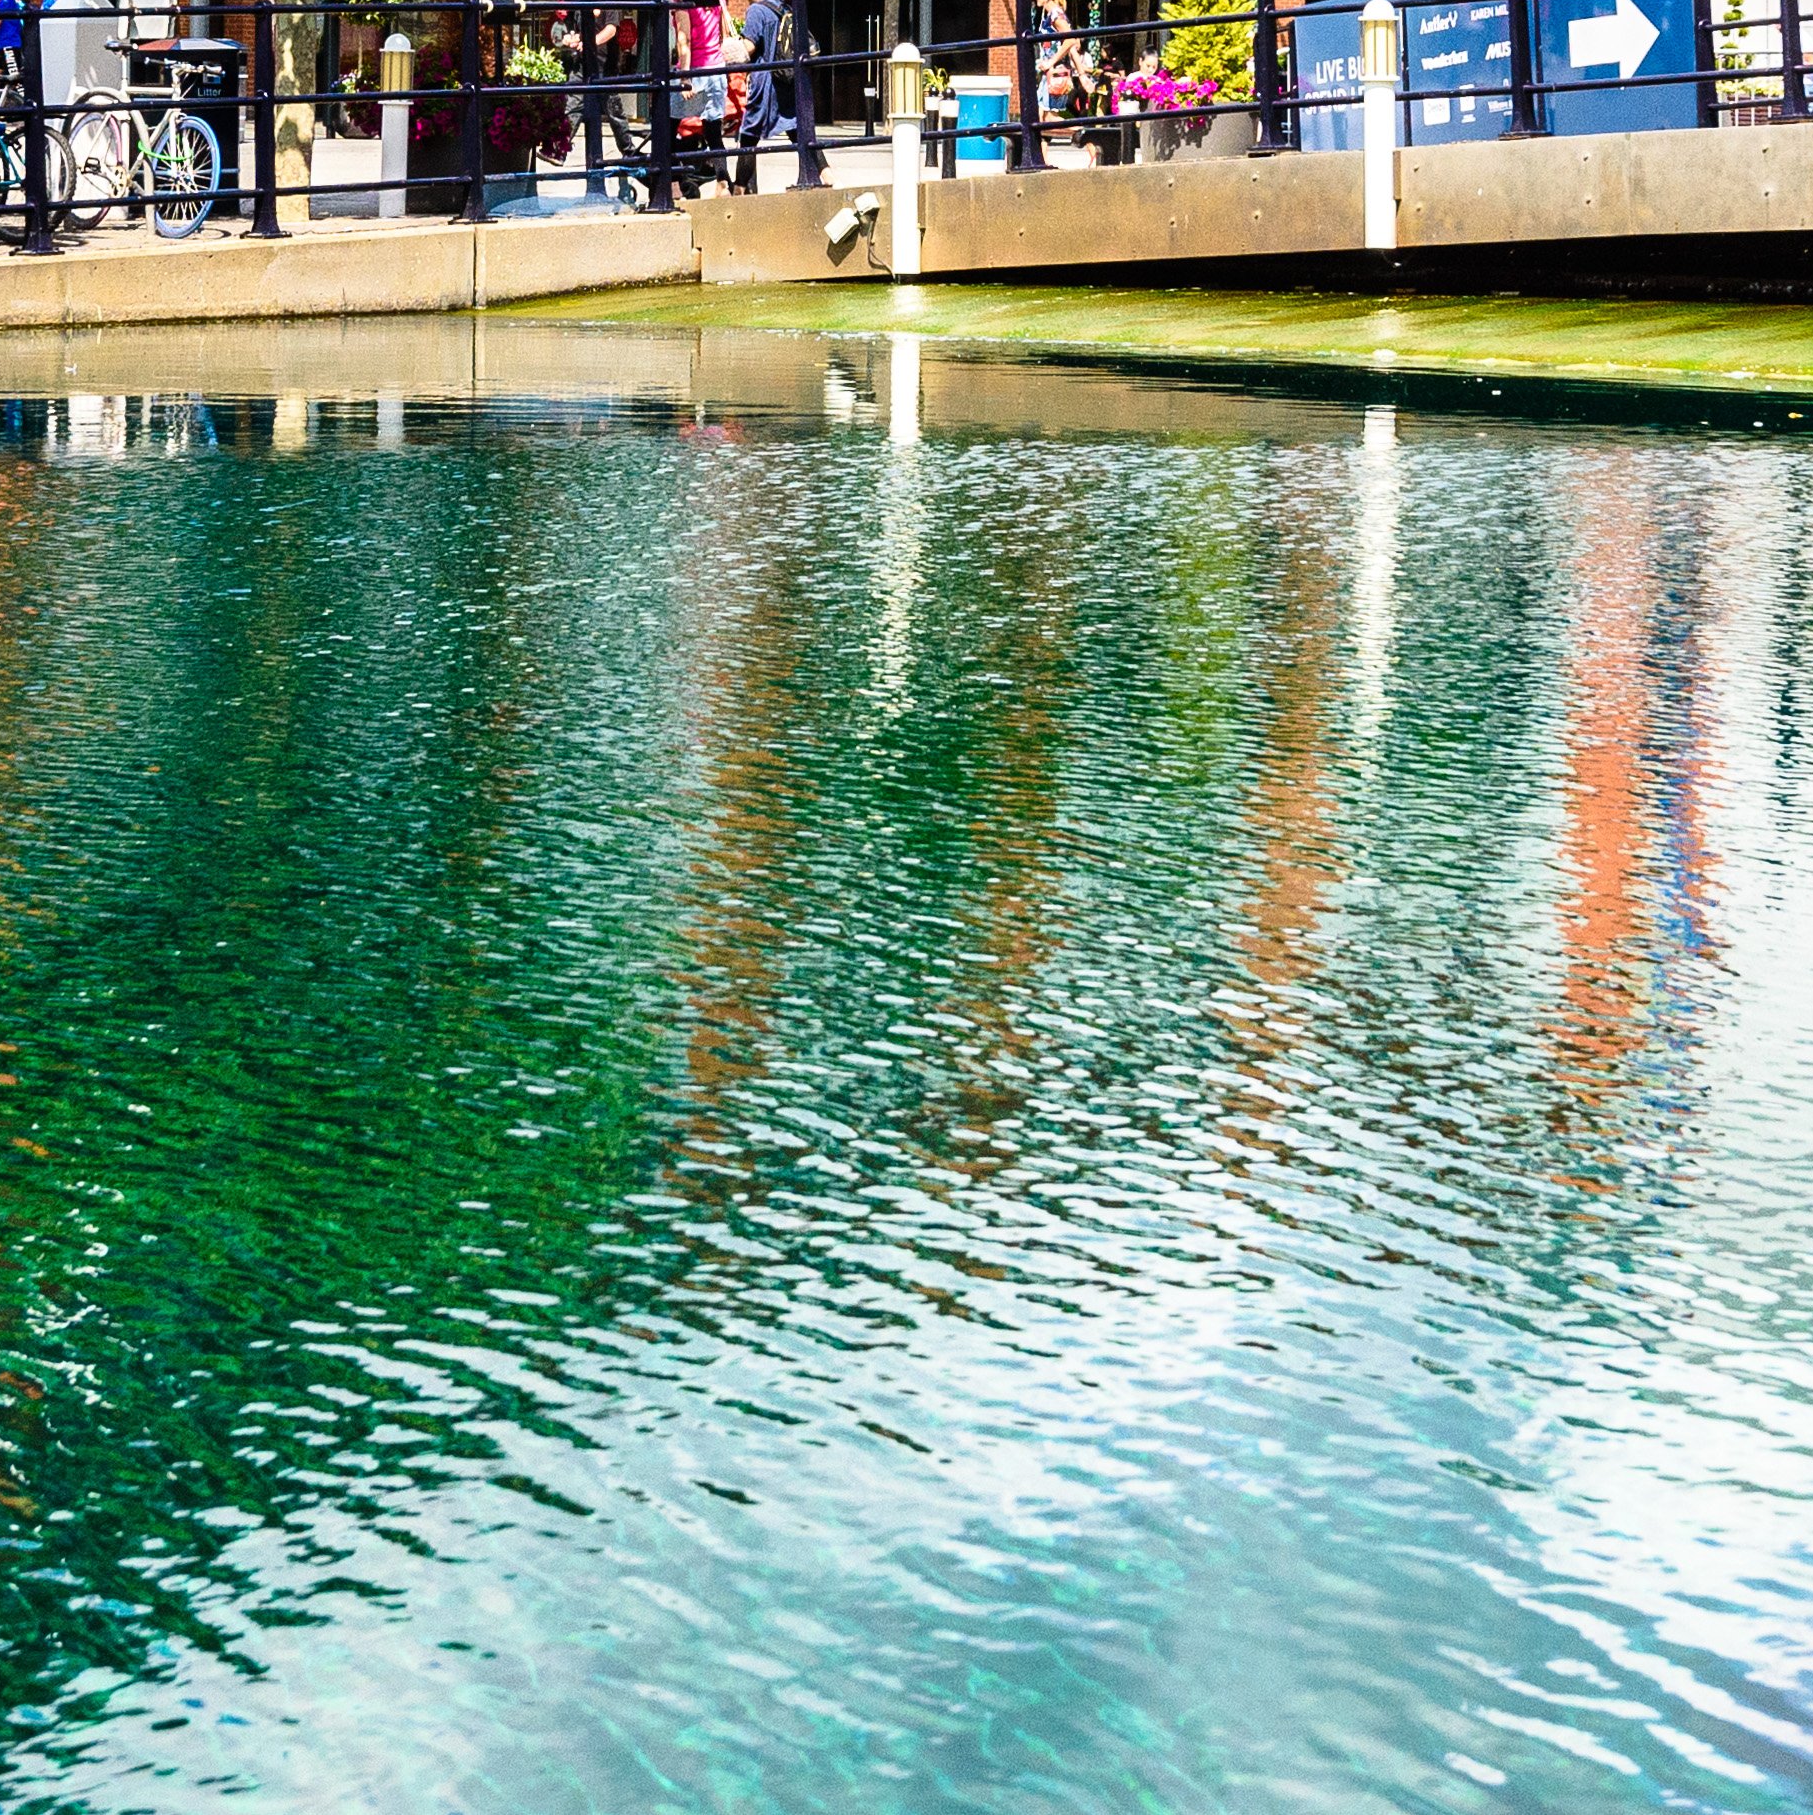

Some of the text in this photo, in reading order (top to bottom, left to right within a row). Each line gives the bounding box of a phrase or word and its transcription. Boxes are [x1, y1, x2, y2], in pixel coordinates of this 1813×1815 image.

[1485, 40, 1511, 61] MUS
[1315, 57, 1345, 84] LIVE
[197, 86, 222, 98] Litter
